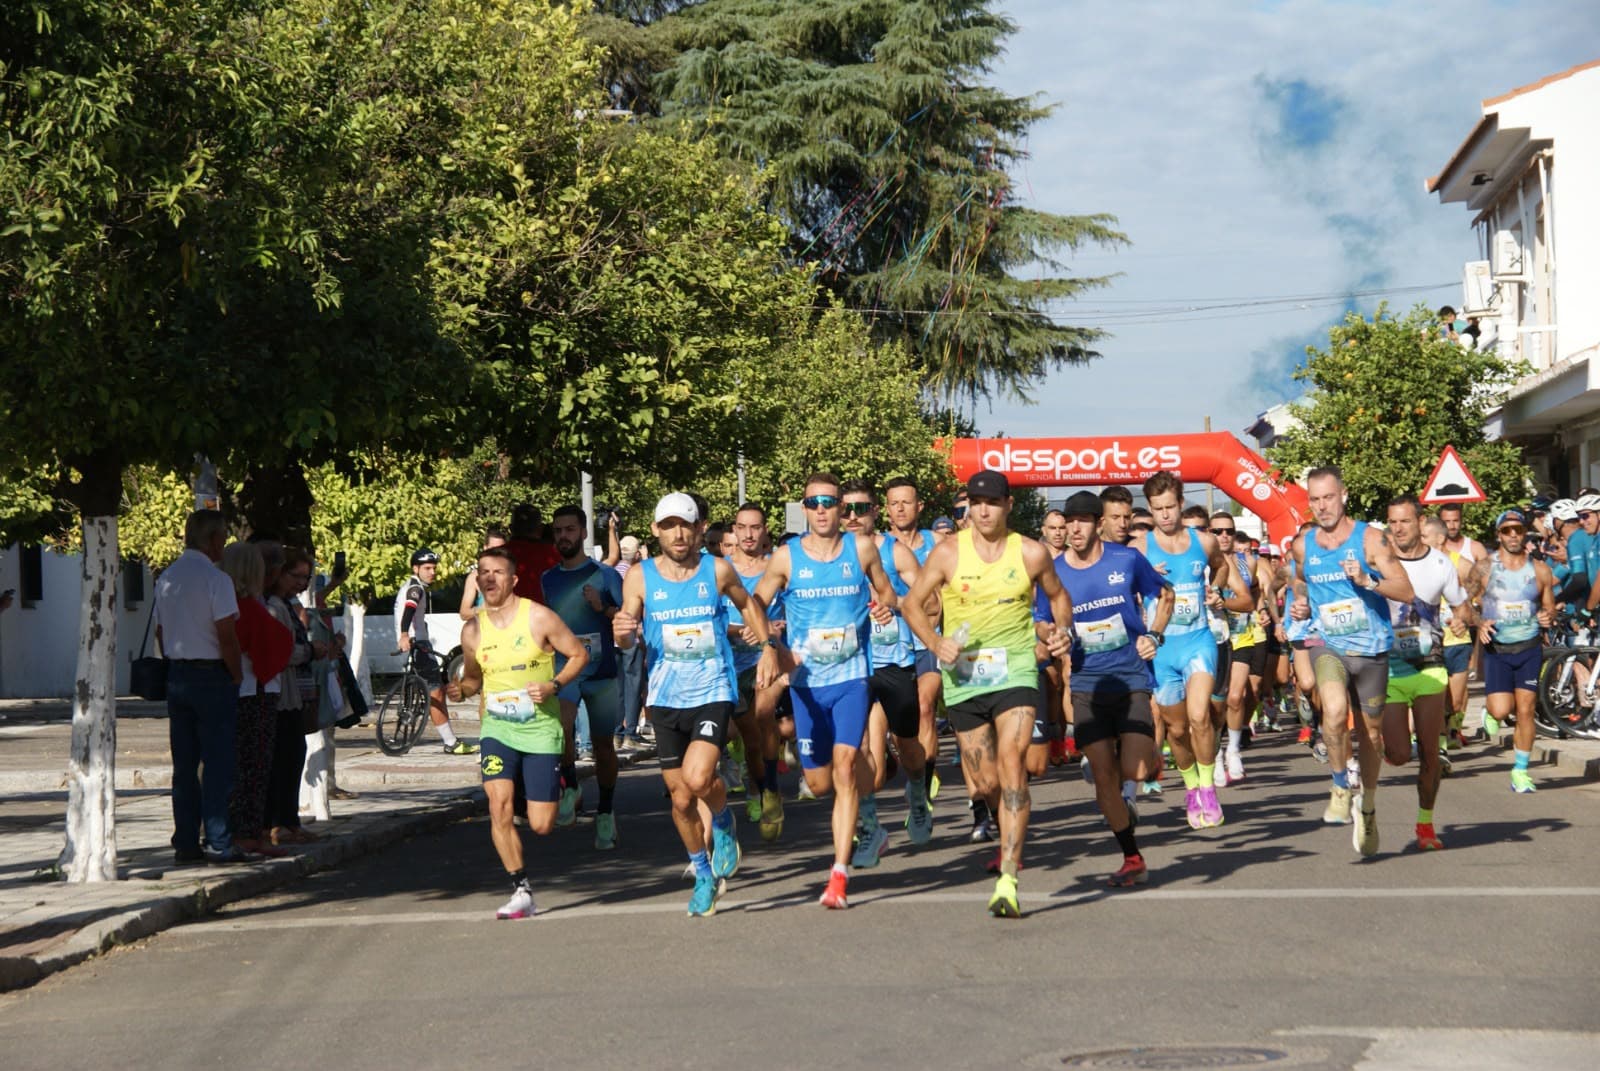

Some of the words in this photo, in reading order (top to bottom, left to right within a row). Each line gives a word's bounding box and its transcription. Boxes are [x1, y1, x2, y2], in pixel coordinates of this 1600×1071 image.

[982, 441, 1181, 480] alssport.es
[1024, 473, 1054, 481] TIENDA
[1109, 471, 1132, 479] TRAIL
[795, 584, 860, 599] TROTASIERRA
[1331, 611, 1353, 624] 707
[1098, 632, 1105, 642] 7
[685, 638, 694, 649] 2
[832, 641, 840, 651] 4
[977, 663, 985, 676] 6
